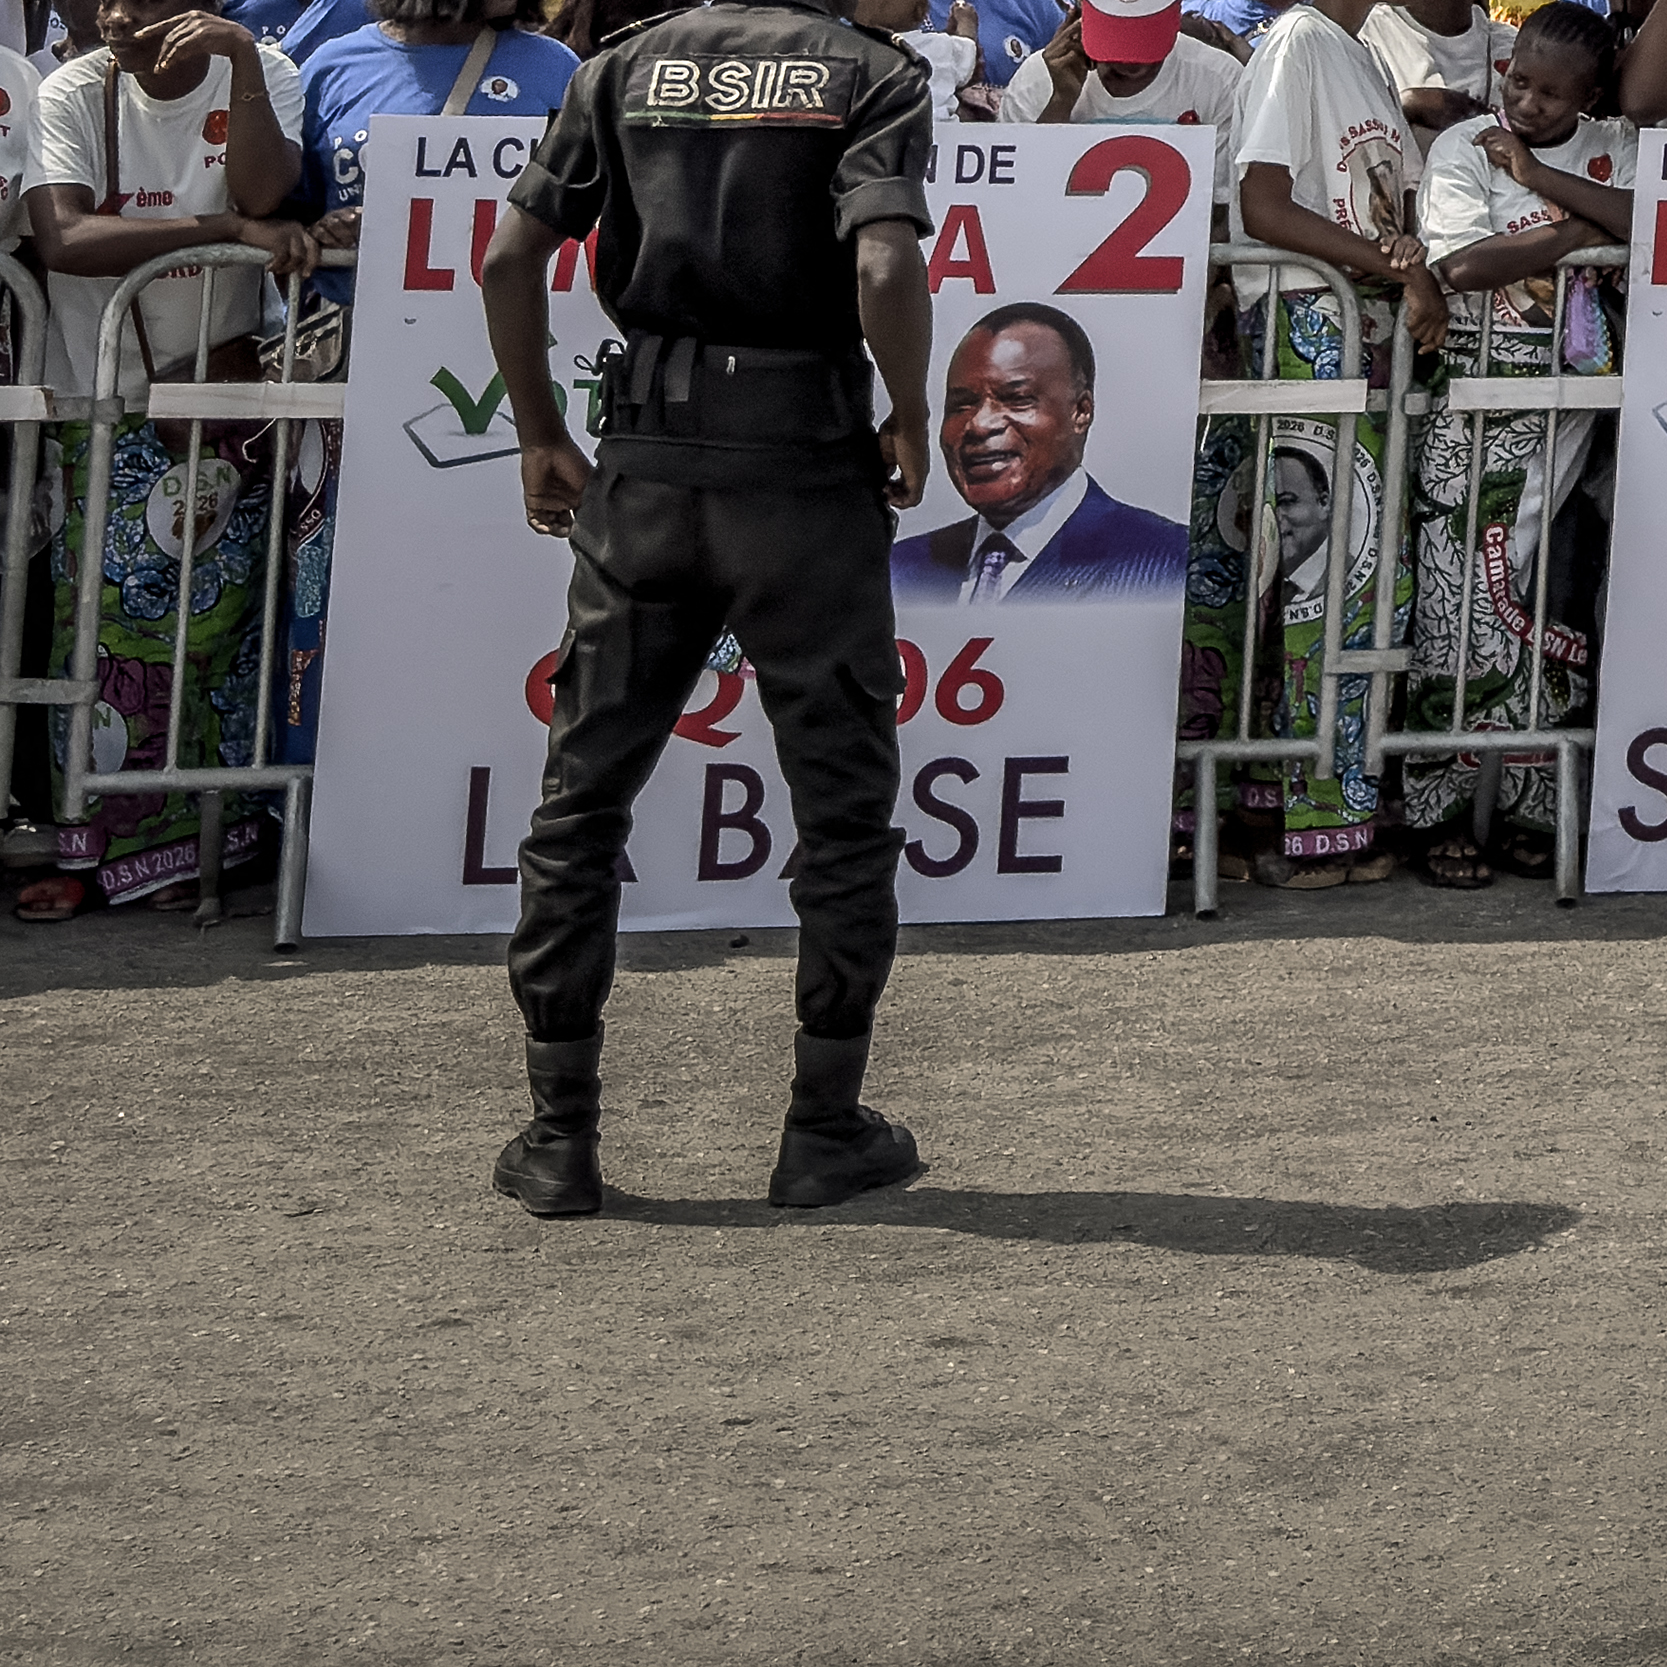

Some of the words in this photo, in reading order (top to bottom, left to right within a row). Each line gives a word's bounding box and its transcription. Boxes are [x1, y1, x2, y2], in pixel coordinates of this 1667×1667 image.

[647, 59, 830, 112] BSIR
[415, 136, 478, 179] LA
[955, 144, 1017, 186] DE
[1055, 134, 1191, 294] 2
[172, 493, 219, 517] 226
[1526, 629, 1569, 661] SN
[895, 637, 1006, 727] 06
[697, 755, 1070, 884] BSE
